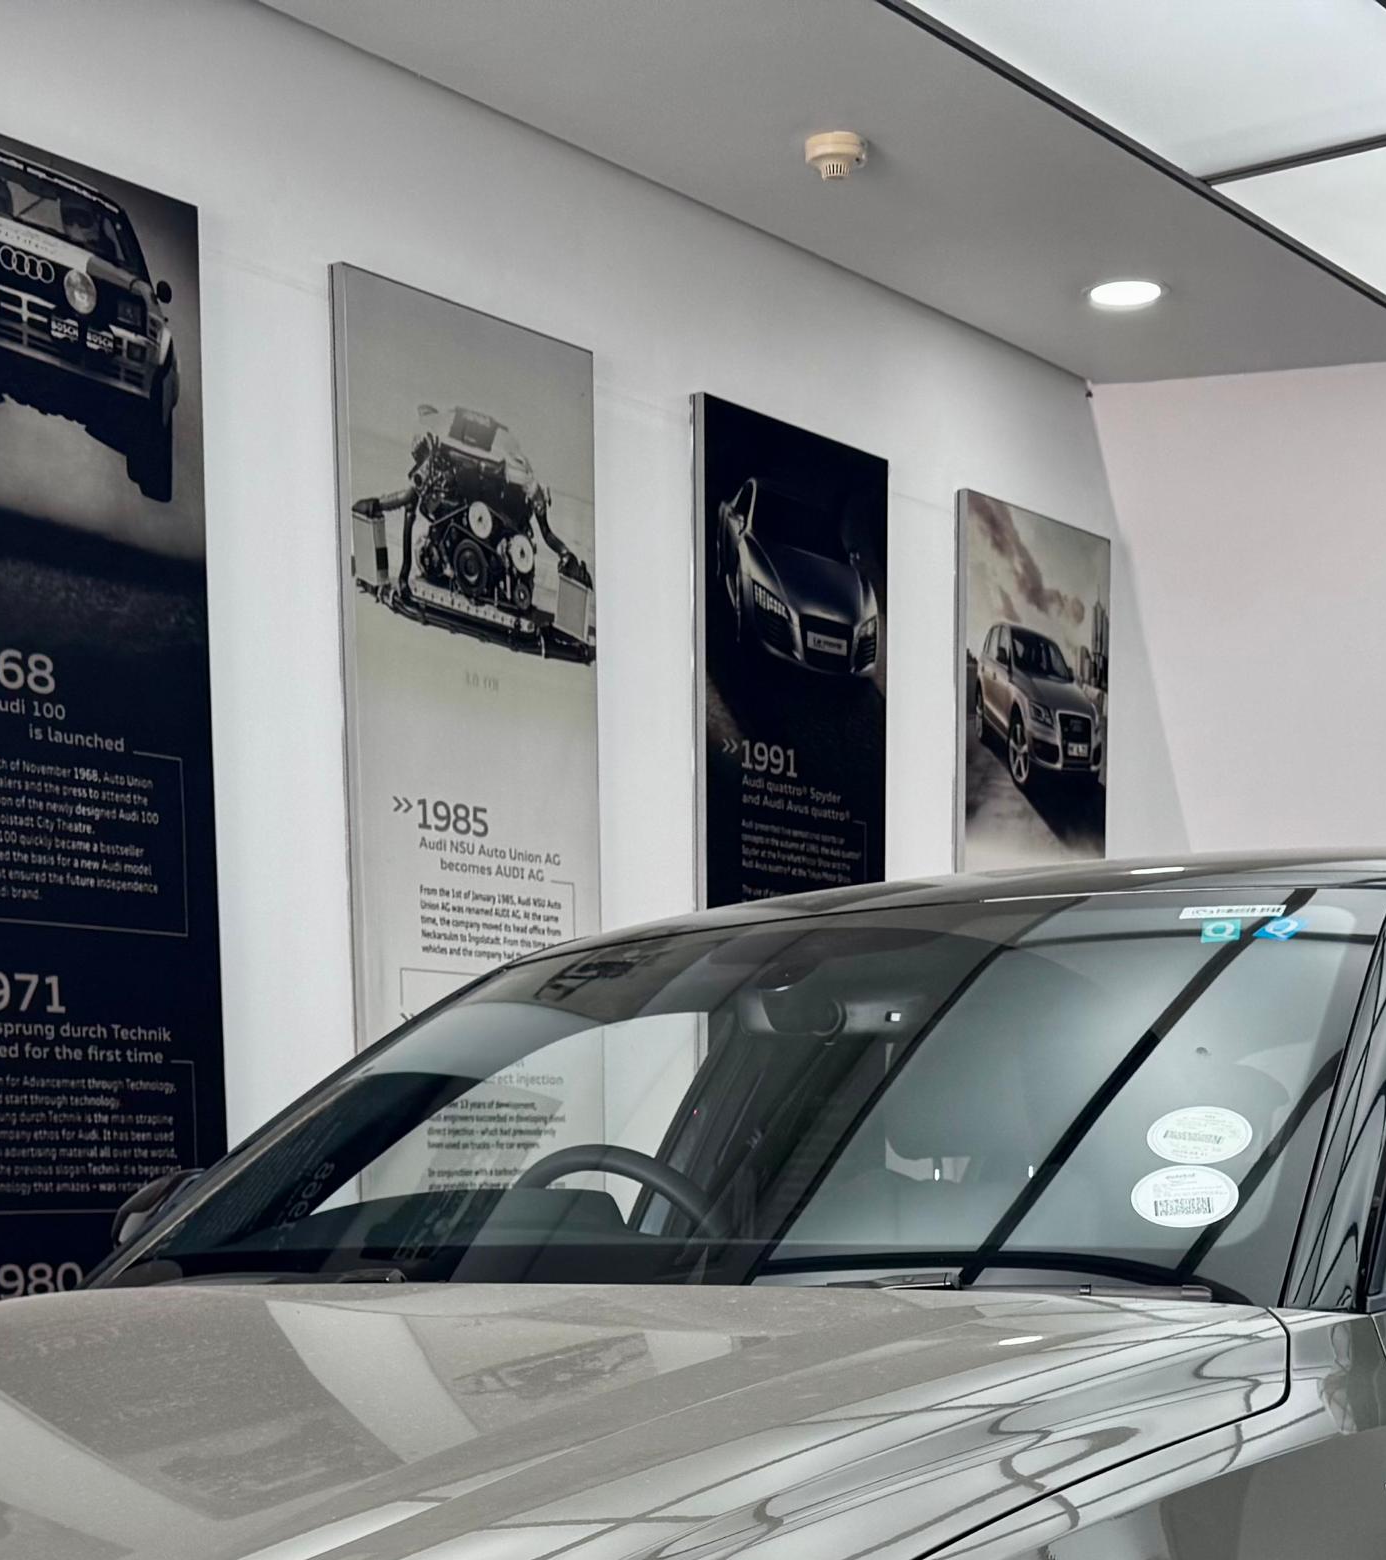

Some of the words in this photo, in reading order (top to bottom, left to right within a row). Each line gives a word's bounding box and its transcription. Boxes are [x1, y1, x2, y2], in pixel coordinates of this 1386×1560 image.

[33, 701, 66, 720] 100
[29, 723, 43, 740] is
[47, 727, 124, 752] launched
[741, 739, 798, 778] 1991
[417, 798, 489, 837] 1985
[419, 836, 447, 852] Audi
[450, 840, 475, 855] NSU
[478, 844, 506, 860] Auto
[509, 848, 542, 864] Union
[544, 852, 561, 866] AG
[440, 858, 492, 876] becomes
[495, 864, 525, 880] AUDI
[527, 868, 544, 882] AG
[59, 1022, 108, 1039] durch
[111, 1024, 171, 1041] Technik
[24, 1042, 50, 1059] for
[54, 1044, 83, 1061] the
[87, 1045, 122, 1062] first
[126, 1048, 163, 1064] time
